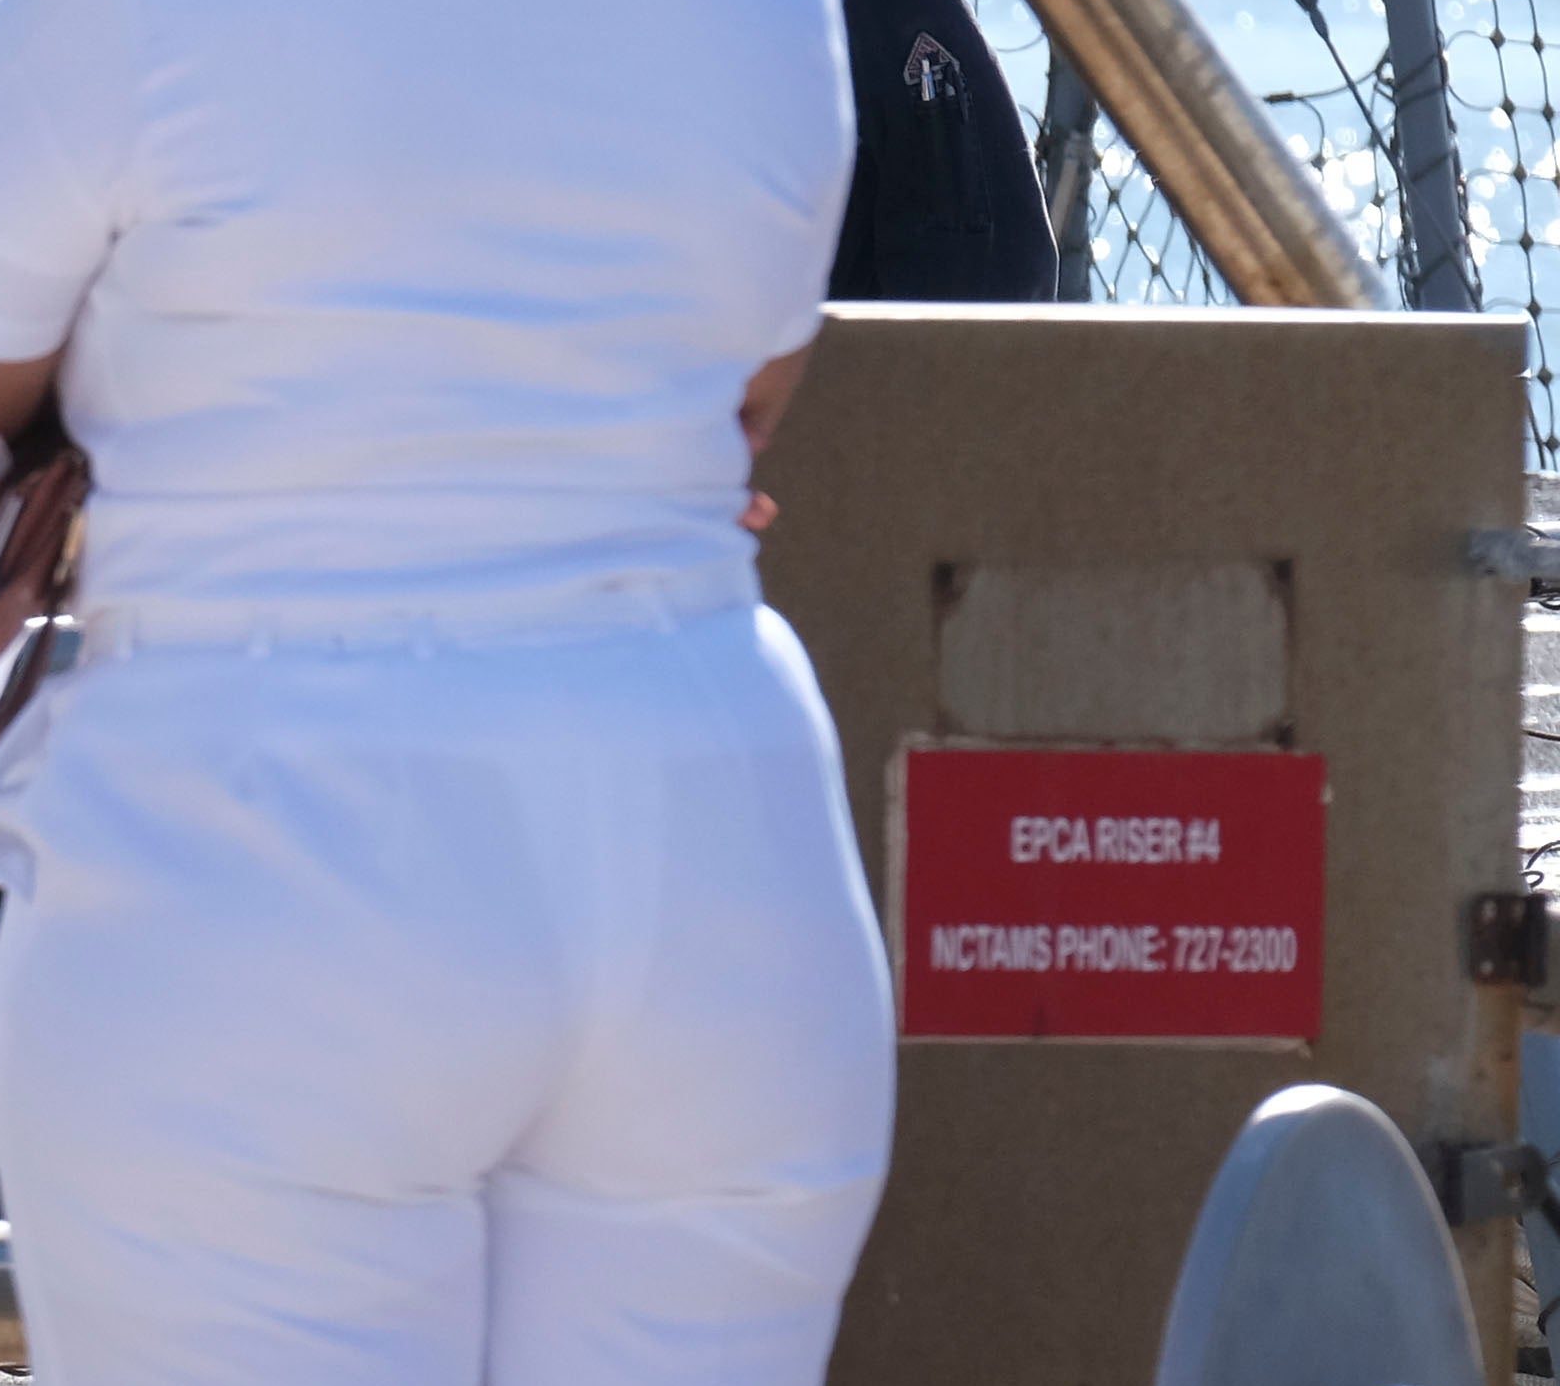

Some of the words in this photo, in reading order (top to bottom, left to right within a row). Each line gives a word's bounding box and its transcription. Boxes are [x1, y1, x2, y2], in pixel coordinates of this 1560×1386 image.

[1010, 815, 1092, 864] EPCA
[1094, 815, 1183, 864] RISER
[1185, 816, 1222, 864] #4
[930, 923, 1052, 973] NCTAMS
[1055, 924, 1168, 974] PHONE:
[1171, 925, 1298, 974] 727-2300
